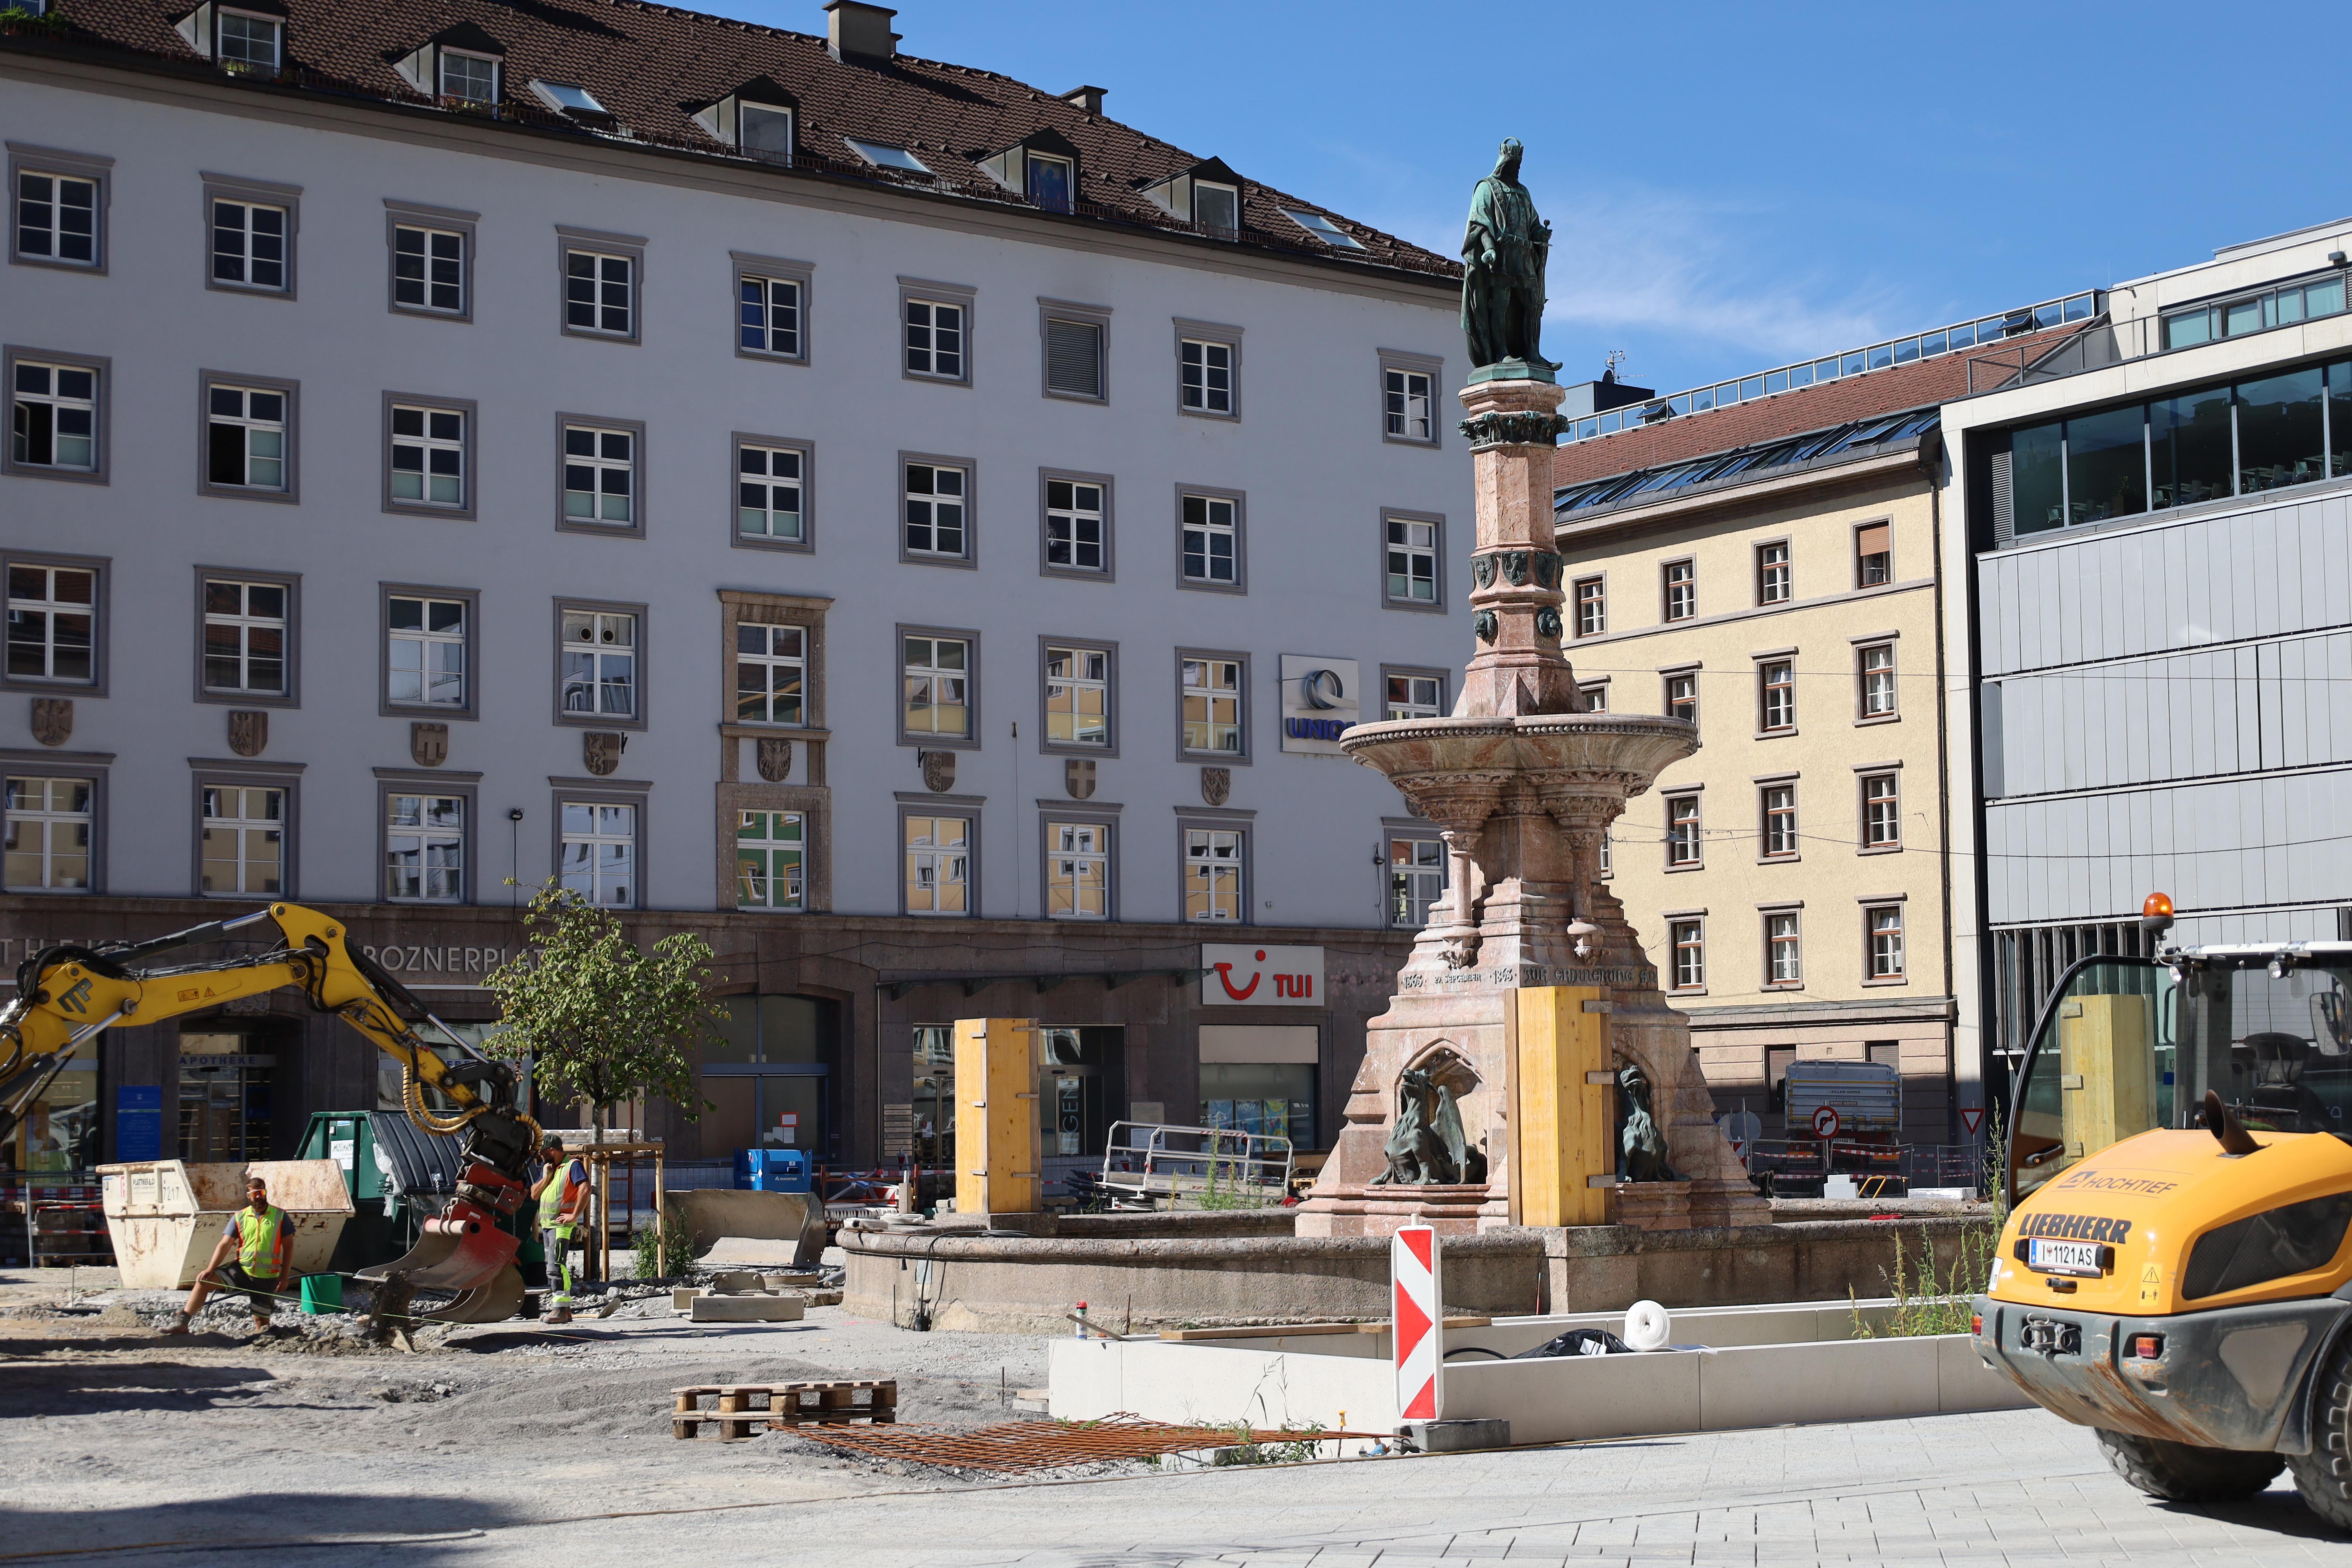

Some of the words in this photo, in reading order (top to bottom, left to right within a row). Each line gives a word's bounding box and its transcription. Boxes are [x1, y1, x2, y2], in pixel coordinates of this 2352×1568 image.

[1444, 973, 1481, 983] SEPTEMBER
[1273, 974, 1312, 997] TUI
[179, 1056, 255, 1065] APOTHEKE
[748, 1152, 752, 1161] 7
[2083, 1177, 2178, 1194] HOCHTIEF
[2018, 1213, 2132, 1244] LIEBHERR
